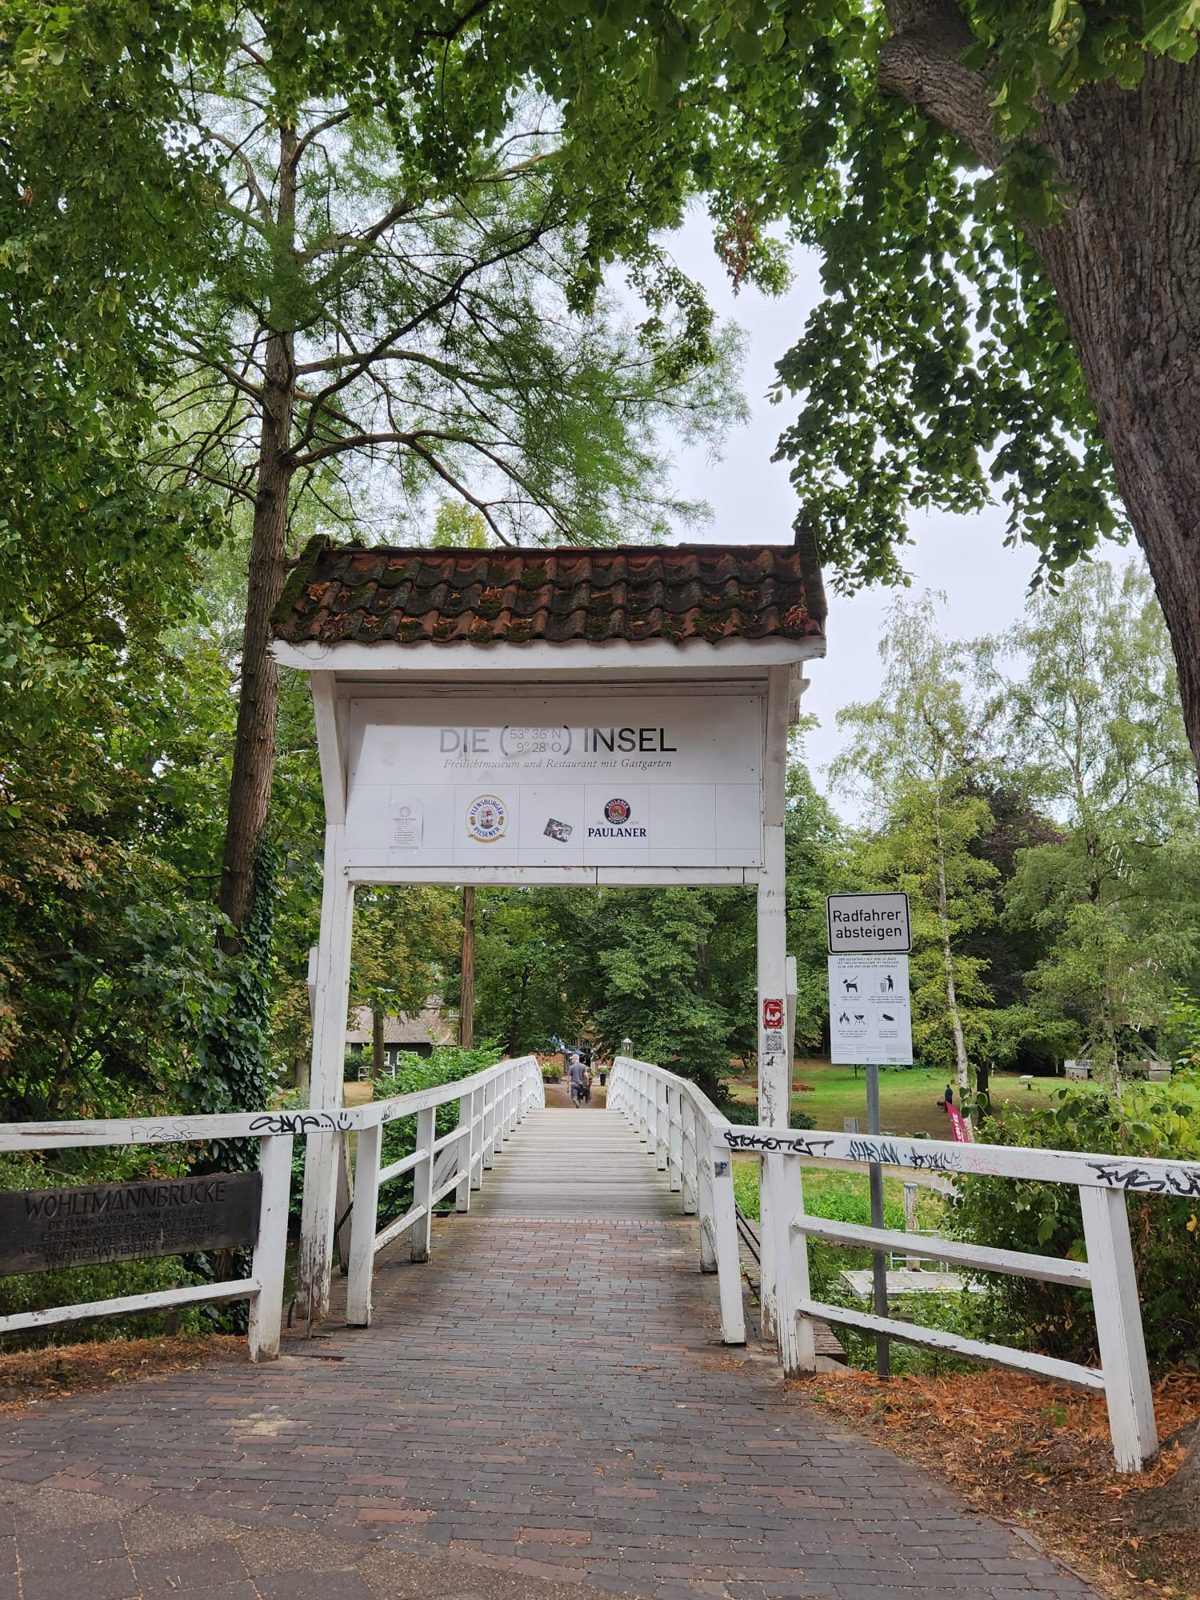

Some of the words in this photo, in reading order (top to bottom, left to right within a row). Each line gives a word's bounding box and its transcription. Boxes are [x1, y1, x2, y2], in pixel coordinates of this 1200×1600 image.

[440, 728, 490, 753] DIE
[552, 728, 561, 740] N
[584, 727, 678, 753] INSEL
[443, 759, 520, 769] Freilichtmuseum
[524, 759, 542, 768] und
[546, 759, 597, 768] Restaurant
[600, 759, 617, 768] mit
[621, 759, 672, 771] Gastgarten
[470, 799, 504, 815] FLENSBURGER
[474, 826, 501, 838] PILSENER
[588, 827, 647, 838] PAULANER
[833, 909, 902, 923] Radfahrer
[836, 924, 902, 941] absteigen
